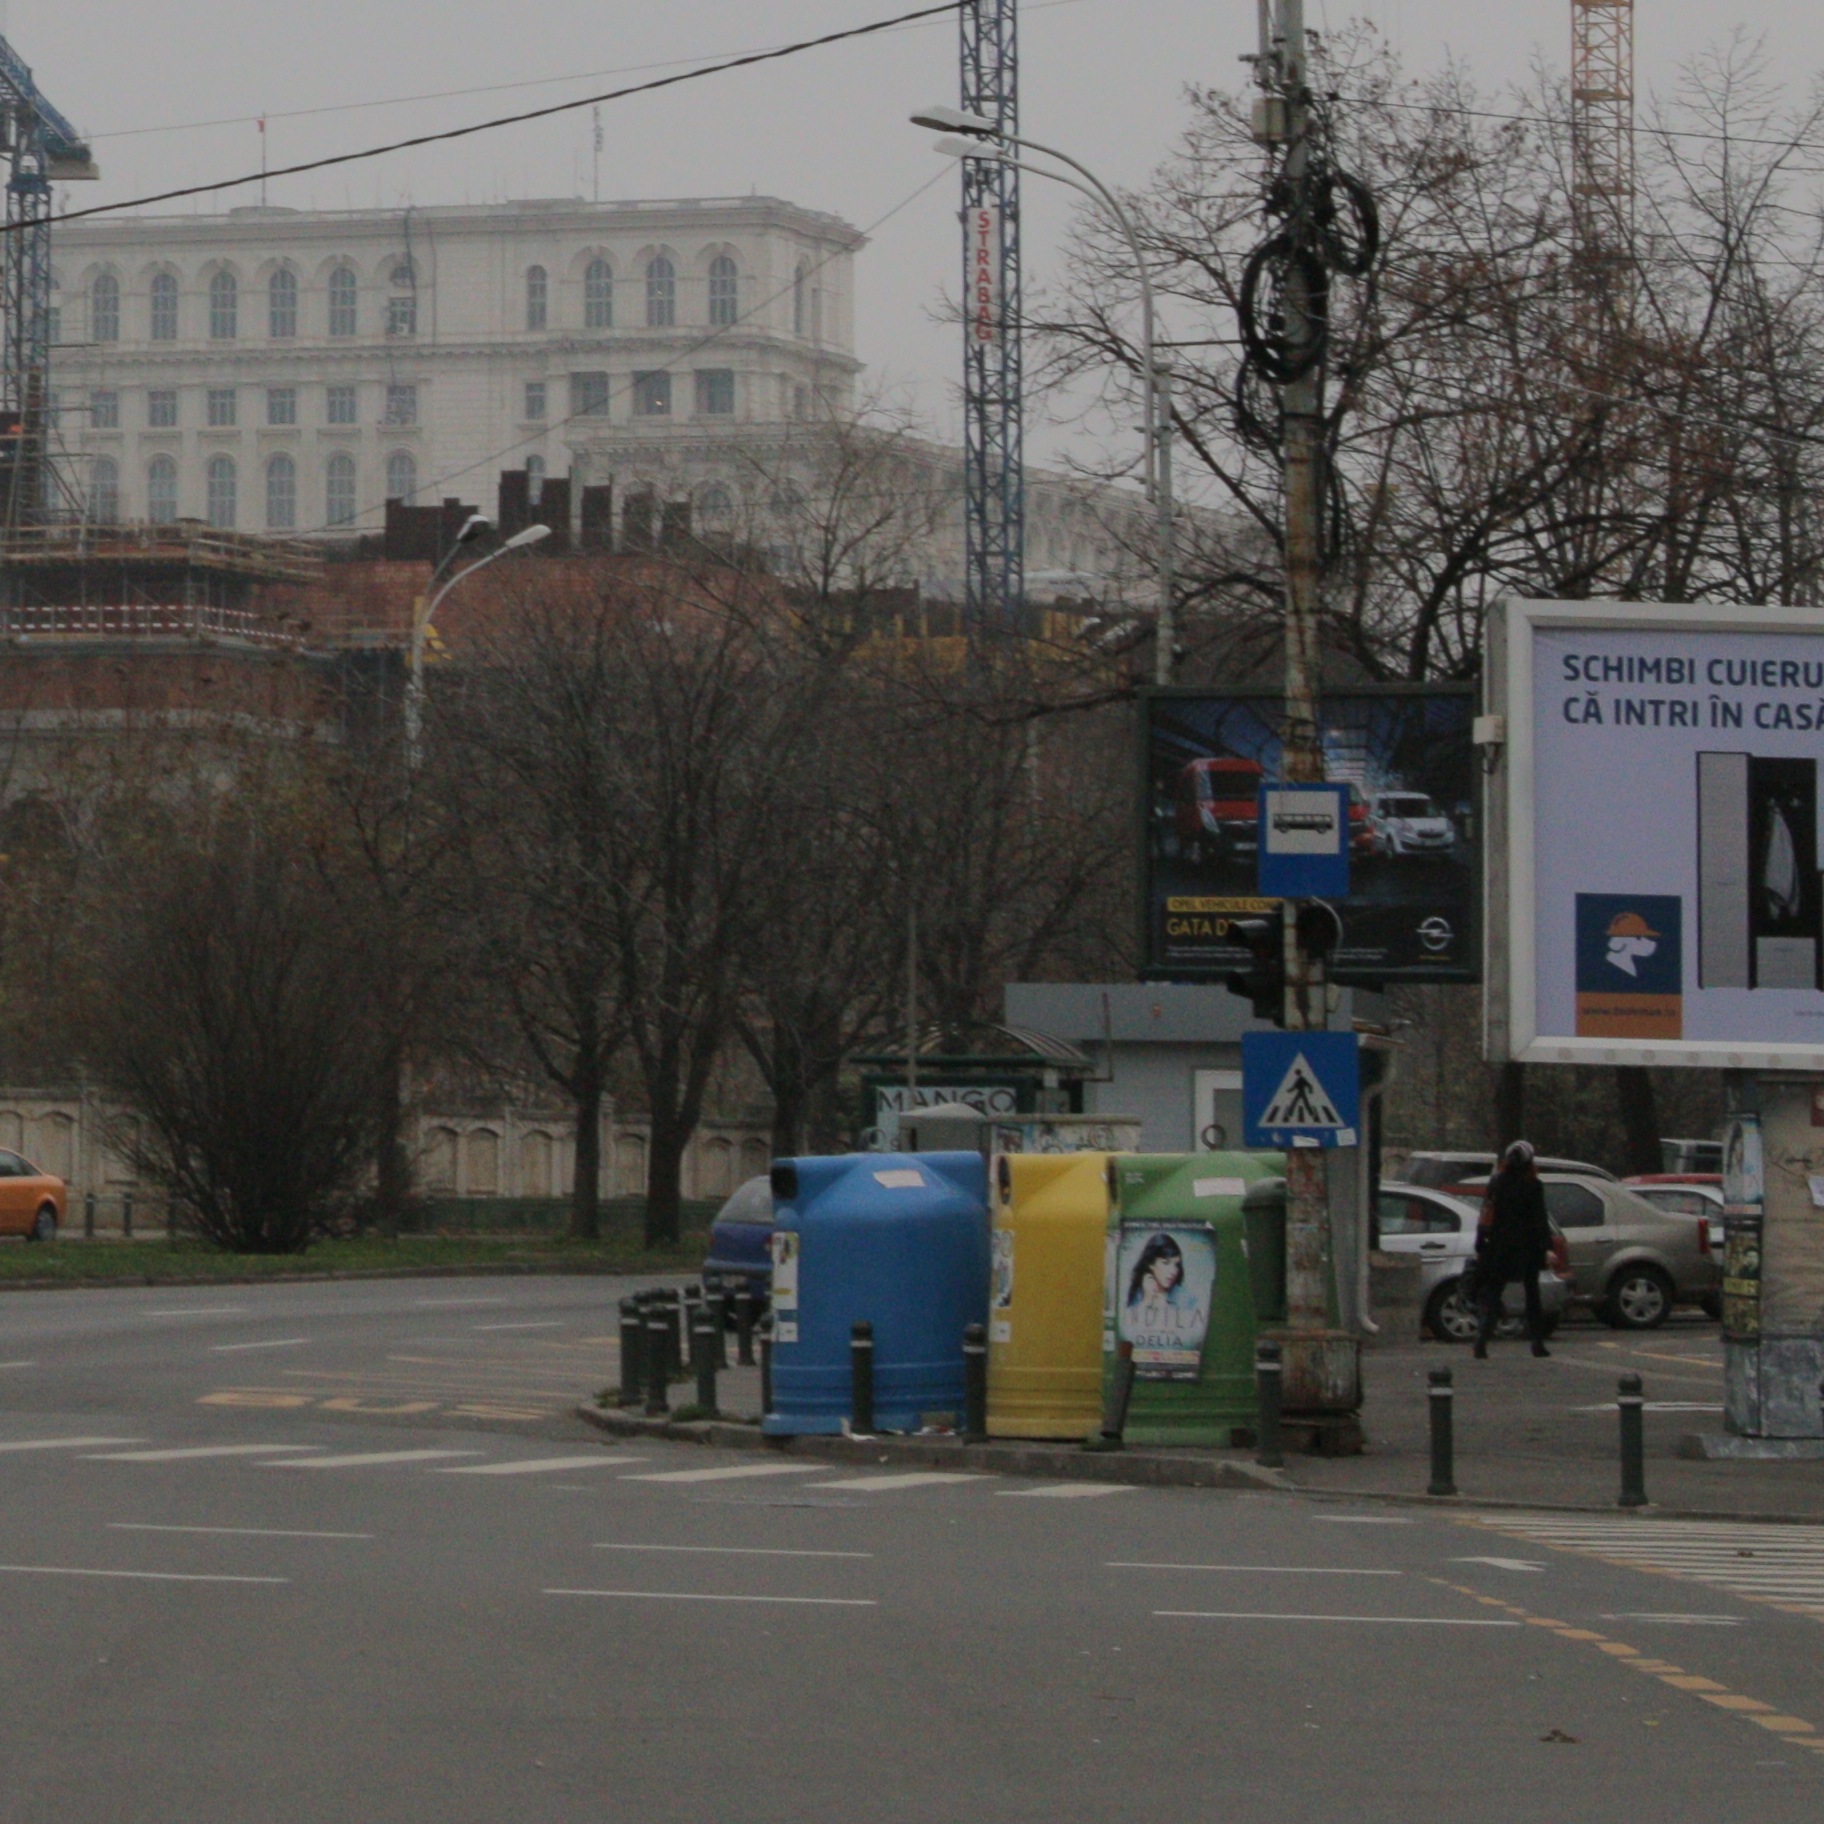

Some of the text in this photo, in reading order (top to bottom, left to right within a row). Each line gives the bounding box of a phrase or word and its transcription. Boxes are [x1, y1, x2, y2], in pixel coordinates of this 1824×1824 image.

[975, 210, 993, 341] STRABAG
[1562, 654, 1695, 684] SCHIMBI
[1563, 690, 1603, 724] CĂ
[1614, 698, 1699, 727] INTRI
[1708, 693, 1743, 728] ÎN
[1166, 918, 1212, 937] GATA
[878, 1088, 1015, 1118] MANGO
[1135, 1334, 1184, 1348] DELIA
